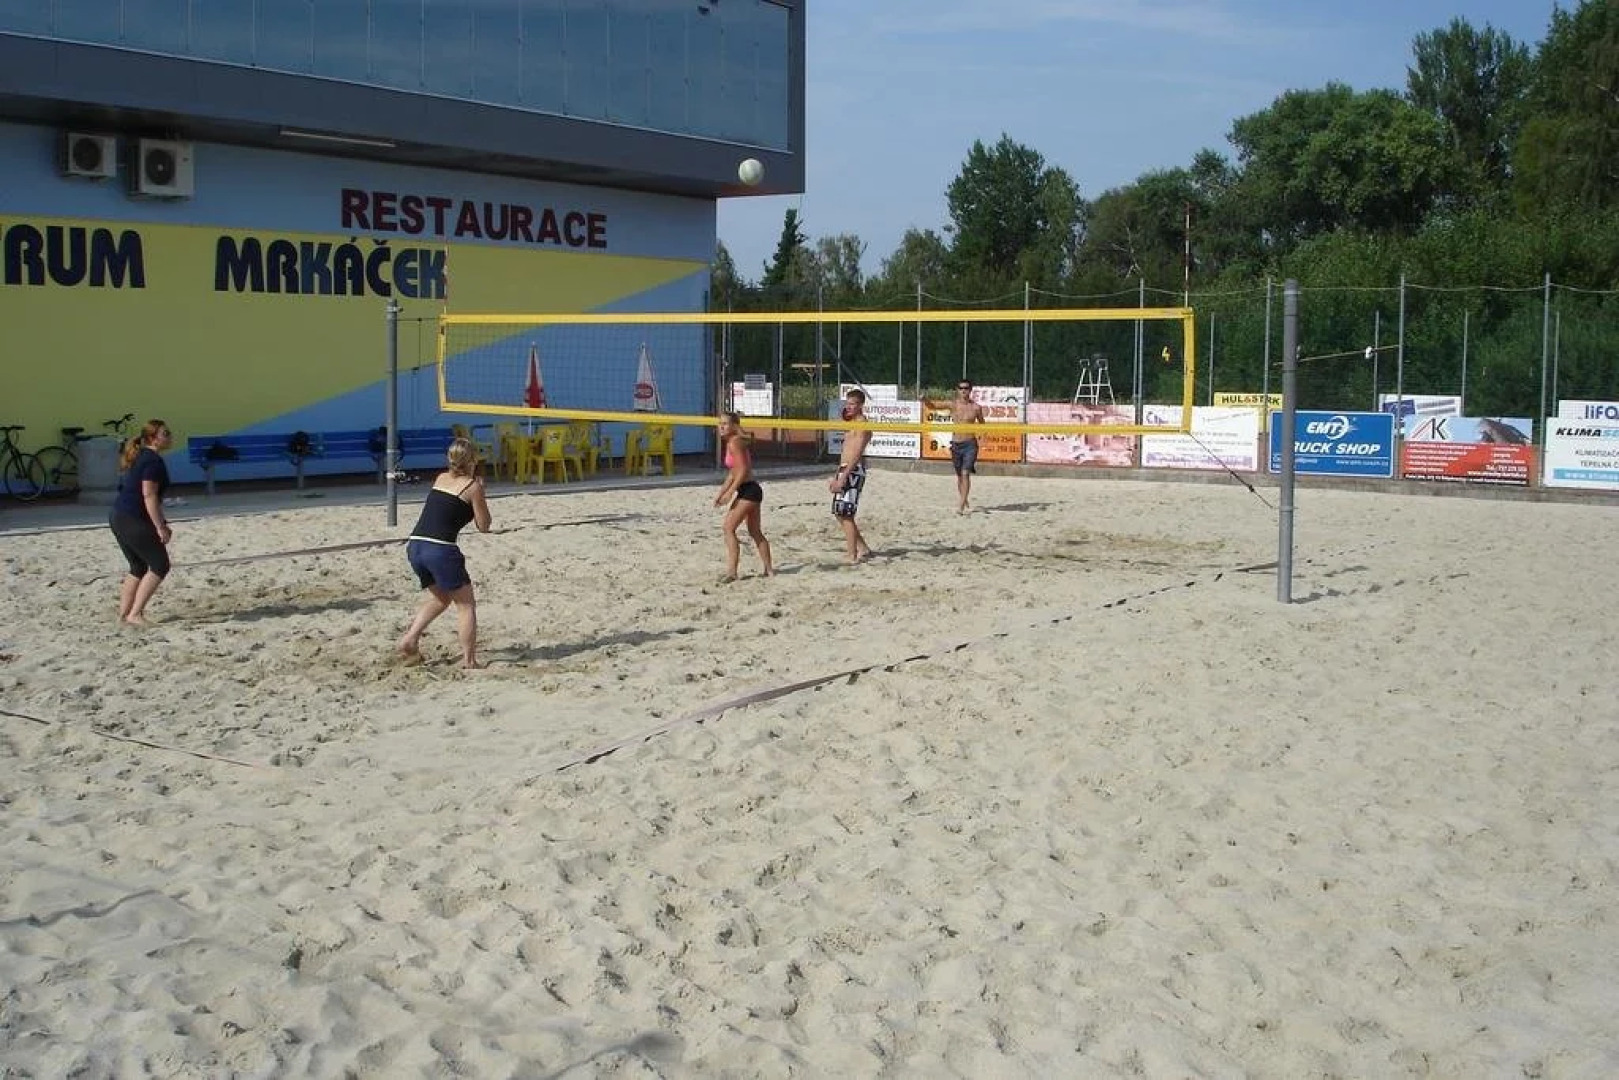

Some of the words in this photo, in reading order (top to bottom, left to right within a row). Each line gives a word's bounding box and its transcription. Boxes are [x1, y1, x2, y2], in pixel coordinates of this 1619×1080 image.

[341, 188, 608, 249] RESTAURACE
[0, 223, 146, 289] RUM
[214, 236, 446, 299] MRKÁČEK
[1585, 405, 1619, 420] liFO
[1335, 443, 1381, 454] SHOP
